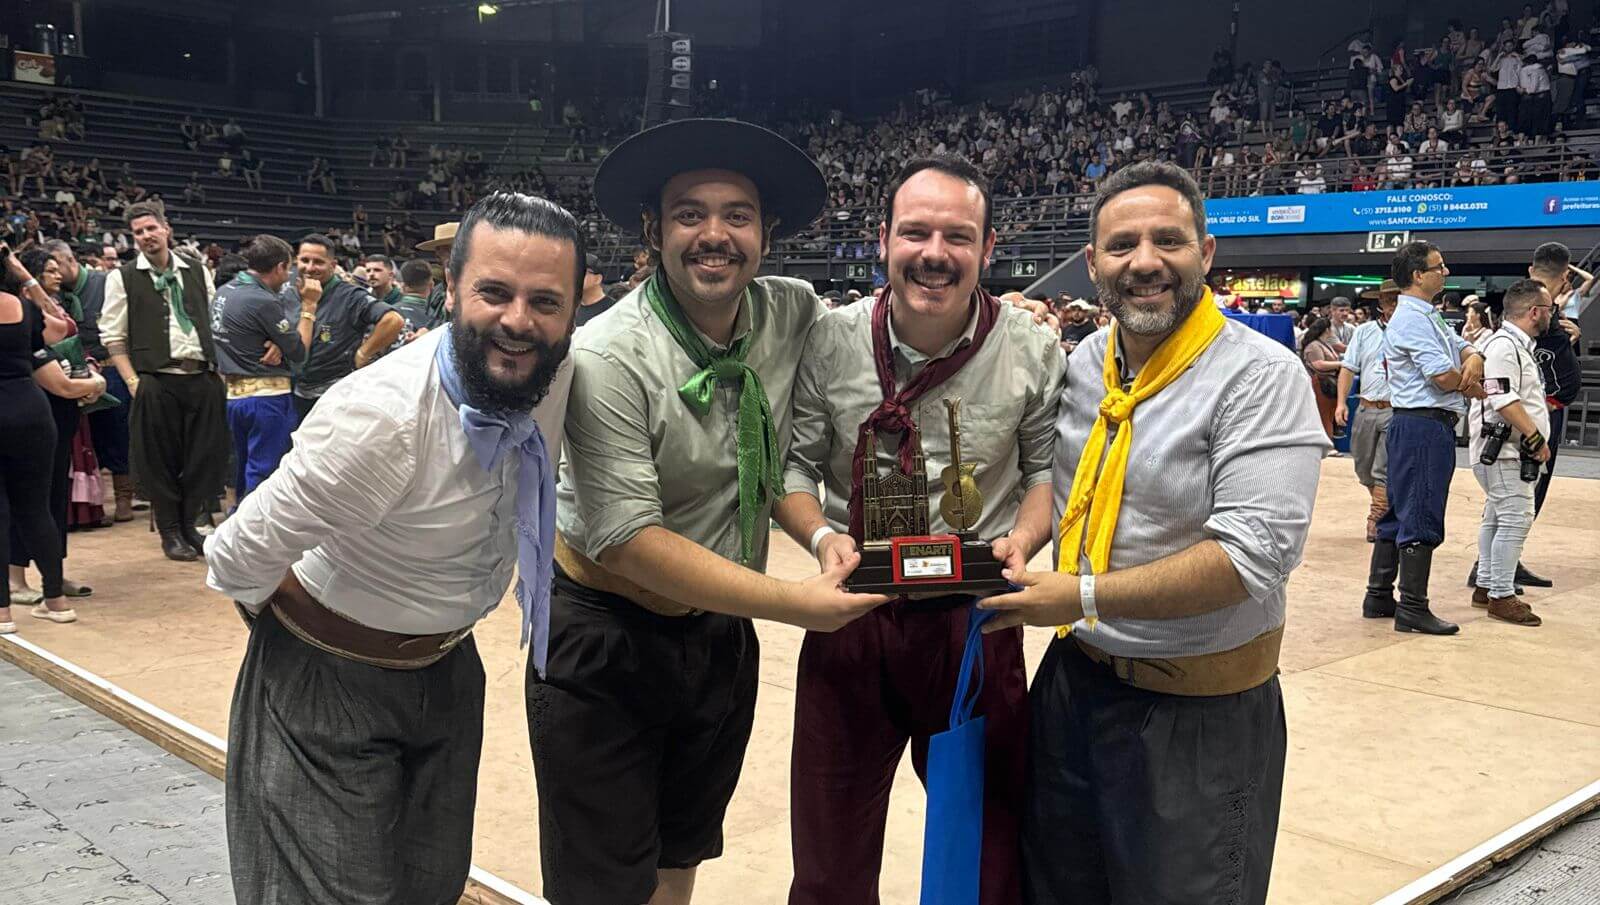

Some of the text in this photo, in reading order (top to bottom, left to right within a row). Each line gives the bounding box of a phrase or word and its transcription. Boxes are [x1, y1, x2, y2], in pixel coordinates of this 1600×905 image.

[1387, 193, 1453, 203] FALE CONOSCO:
[1369, 216, 1466, 225] www.SANTACRUZ.rs.gov.br
[910, 545, 947, 555] ENART
